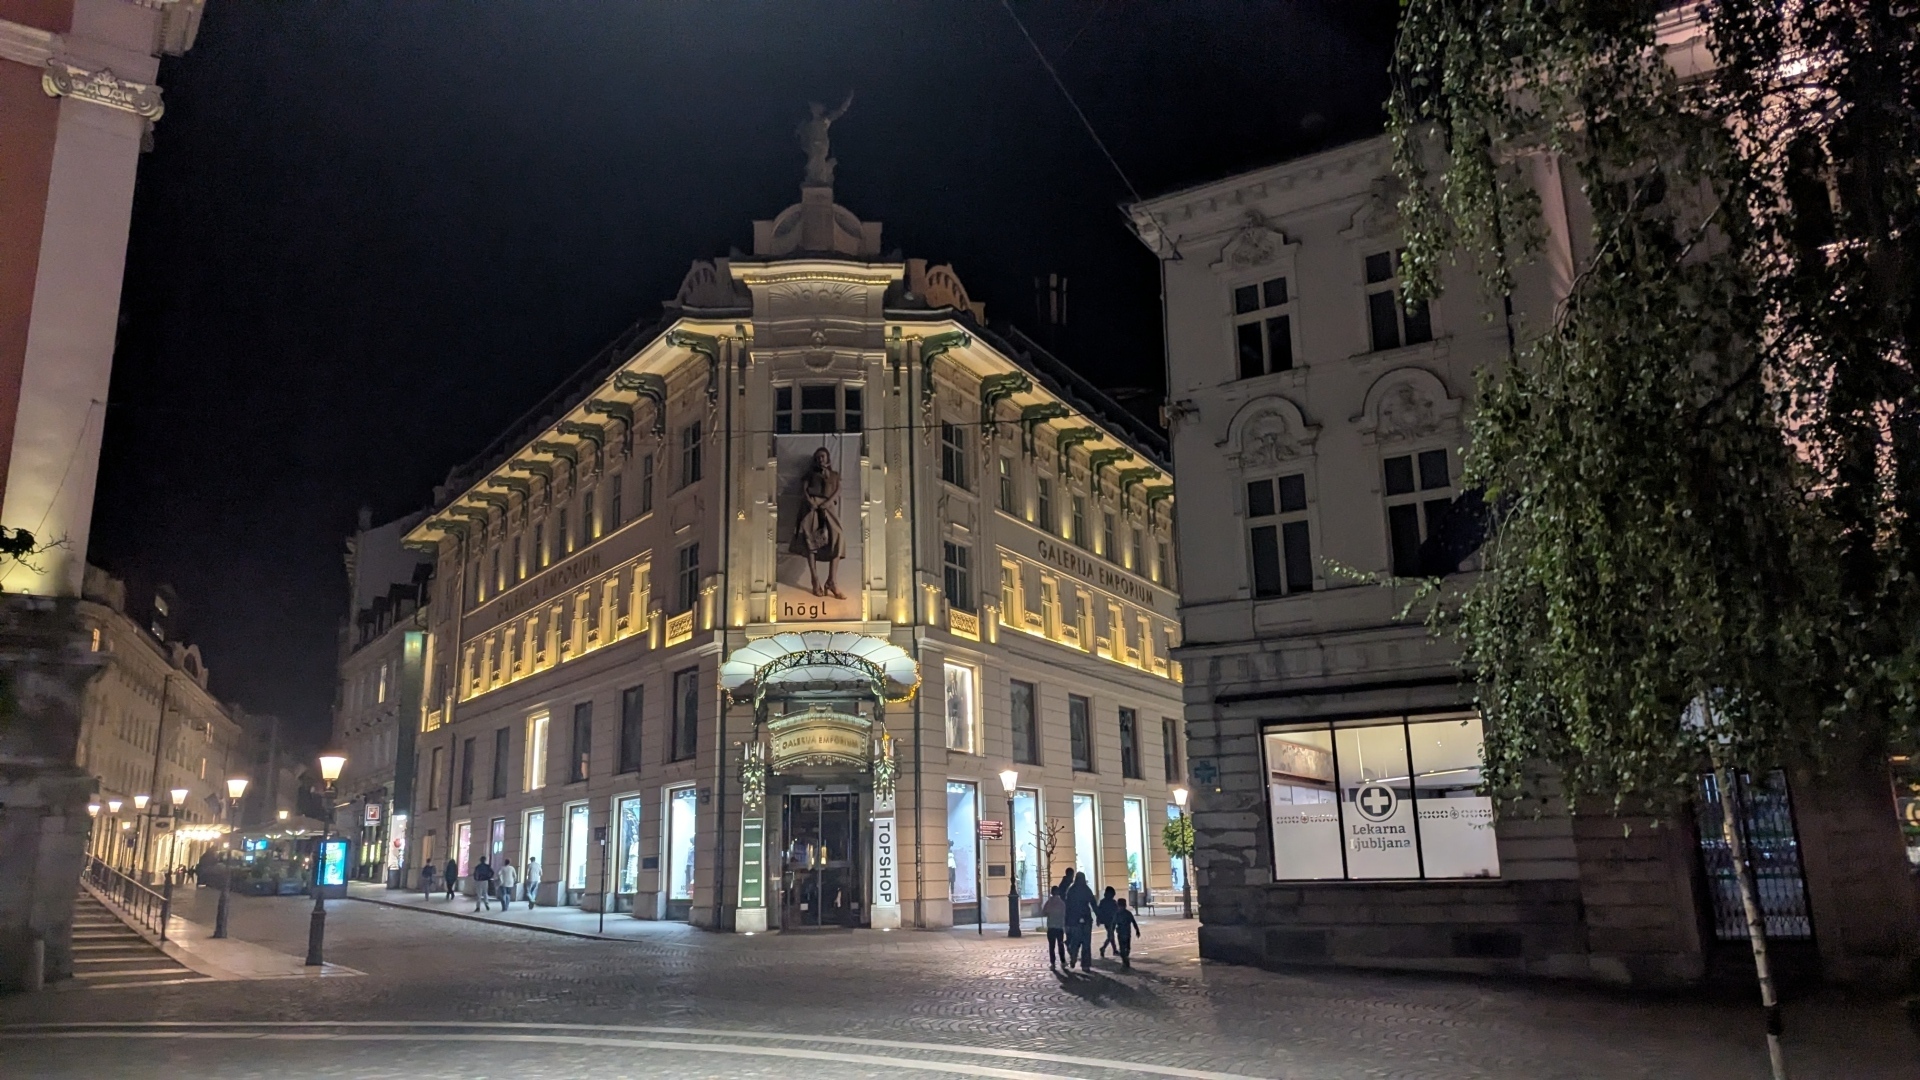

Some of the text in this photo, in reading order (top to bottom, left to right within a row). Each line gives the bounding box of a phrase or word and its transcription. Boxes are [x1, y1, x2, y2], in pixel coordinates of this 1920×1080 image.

[1038, 540, 1154, 606] GALERIJA EMPORIUM
[782, 735, 859, 750] GALERIJA EMPORIUM
[1352, 824, 1406, 835] Lekarna
[1349, 838, 1412, 852] Ljubljana
[878, 822, 892, 902] TOPSHOP
